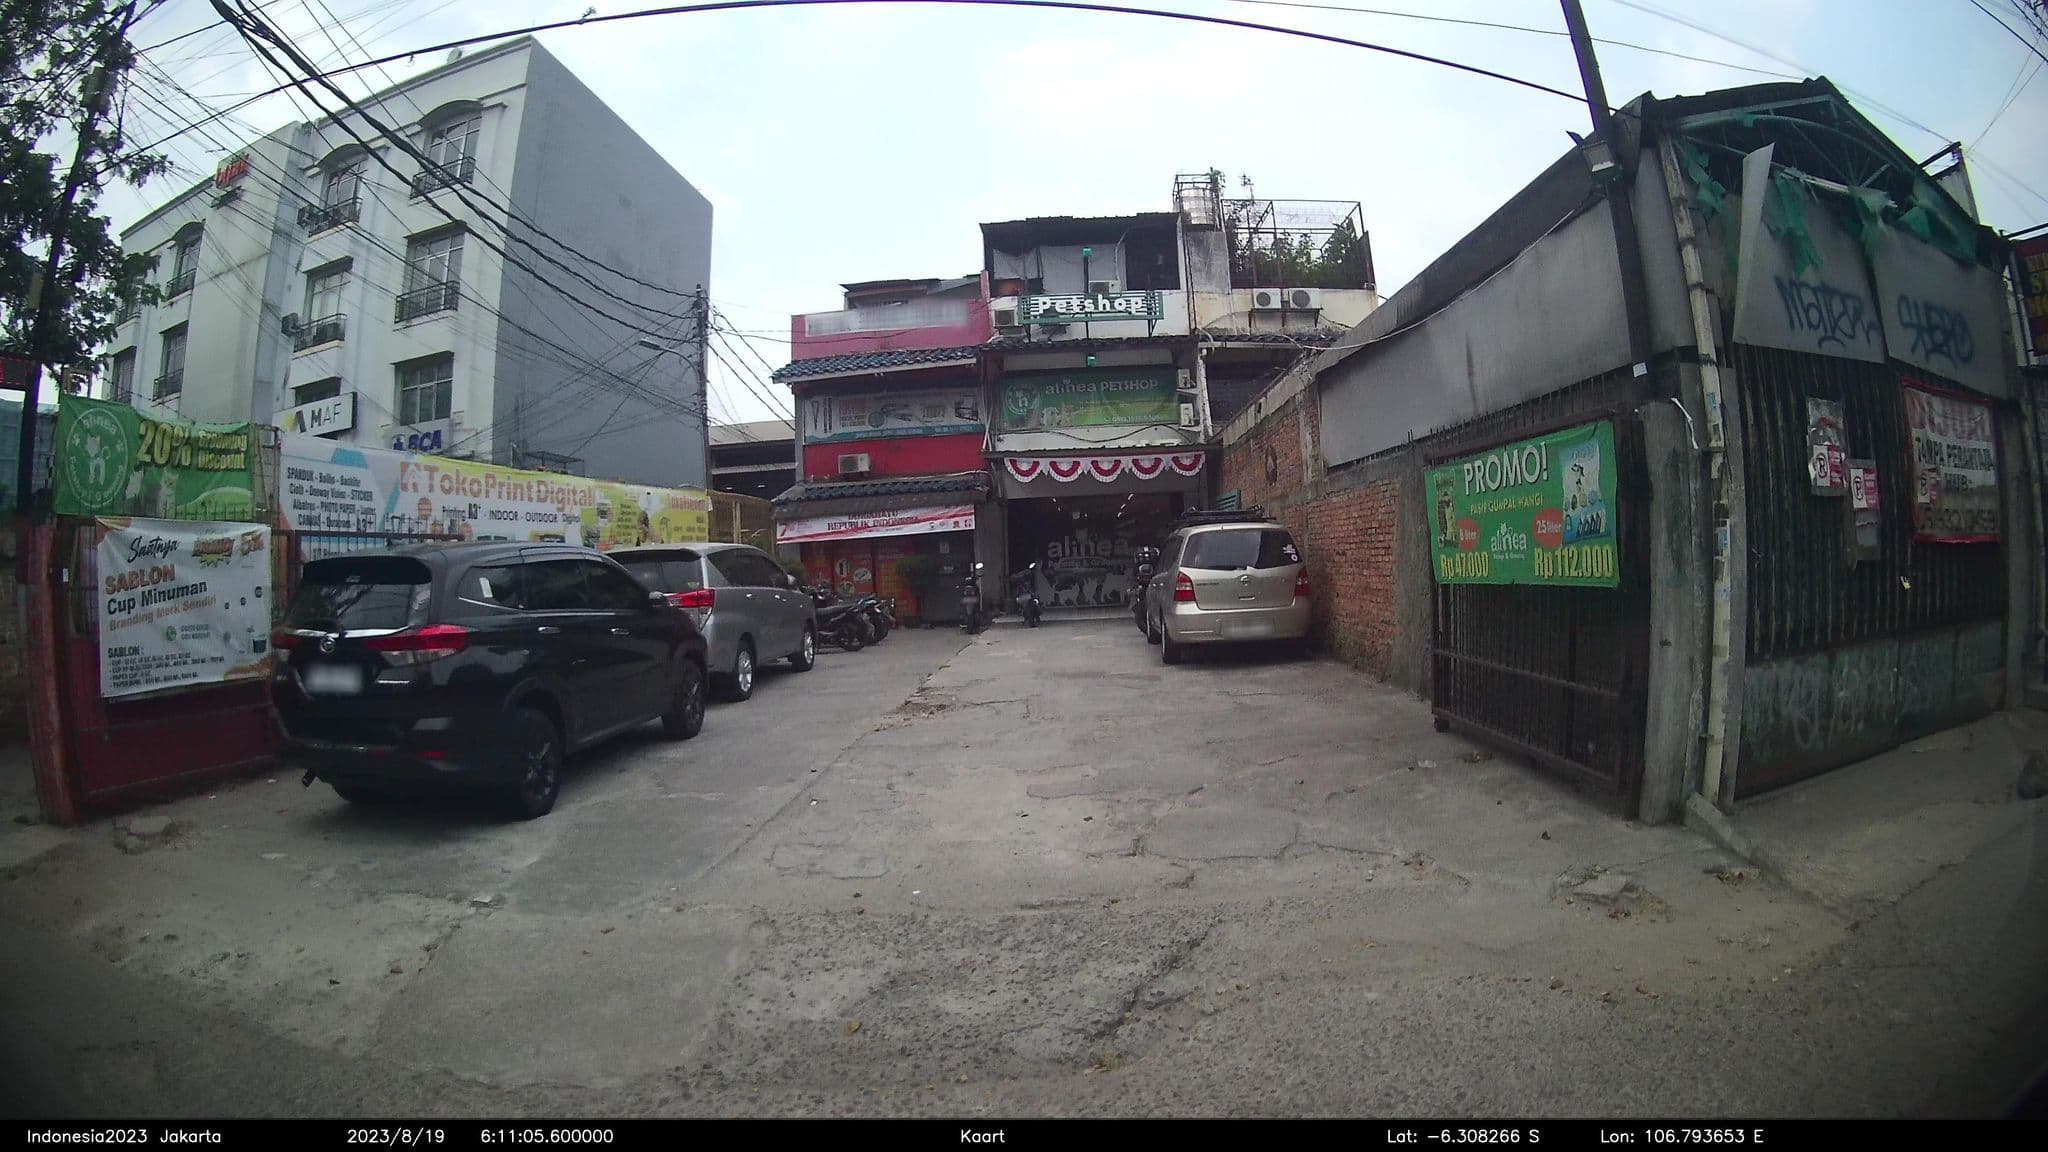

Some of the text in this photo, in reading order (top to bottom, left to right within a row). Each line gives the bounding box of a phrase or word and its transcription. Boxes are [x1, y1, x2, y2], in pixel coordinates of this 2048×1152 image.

[1038, 294, 1143, 314] Petshop
[1046, 377, 1158, 395] alinea PETSHOP
[310, 403, 341, 429] MAF
[137, 419, 192, 467] 20%
[407, 430, 442, 450] BCA
[1464, 442, 1549, 495] PROMO!
[490, 510, 518, 521] INDOOR
[525, 512, 558, 523] OUTDOOR
[827, 518, 872, 531] REPUBLIK
[1048, 536, 1128, 558] alinea
[1491, 522, 1527, 551] alinea
[1535, 546, 1614, 578] Rp 112.000
[105, 563, 176, 595] SABLON
[107, 581, 207, 615] Cup Minuman
[109, 612, 154, 631] Branding
